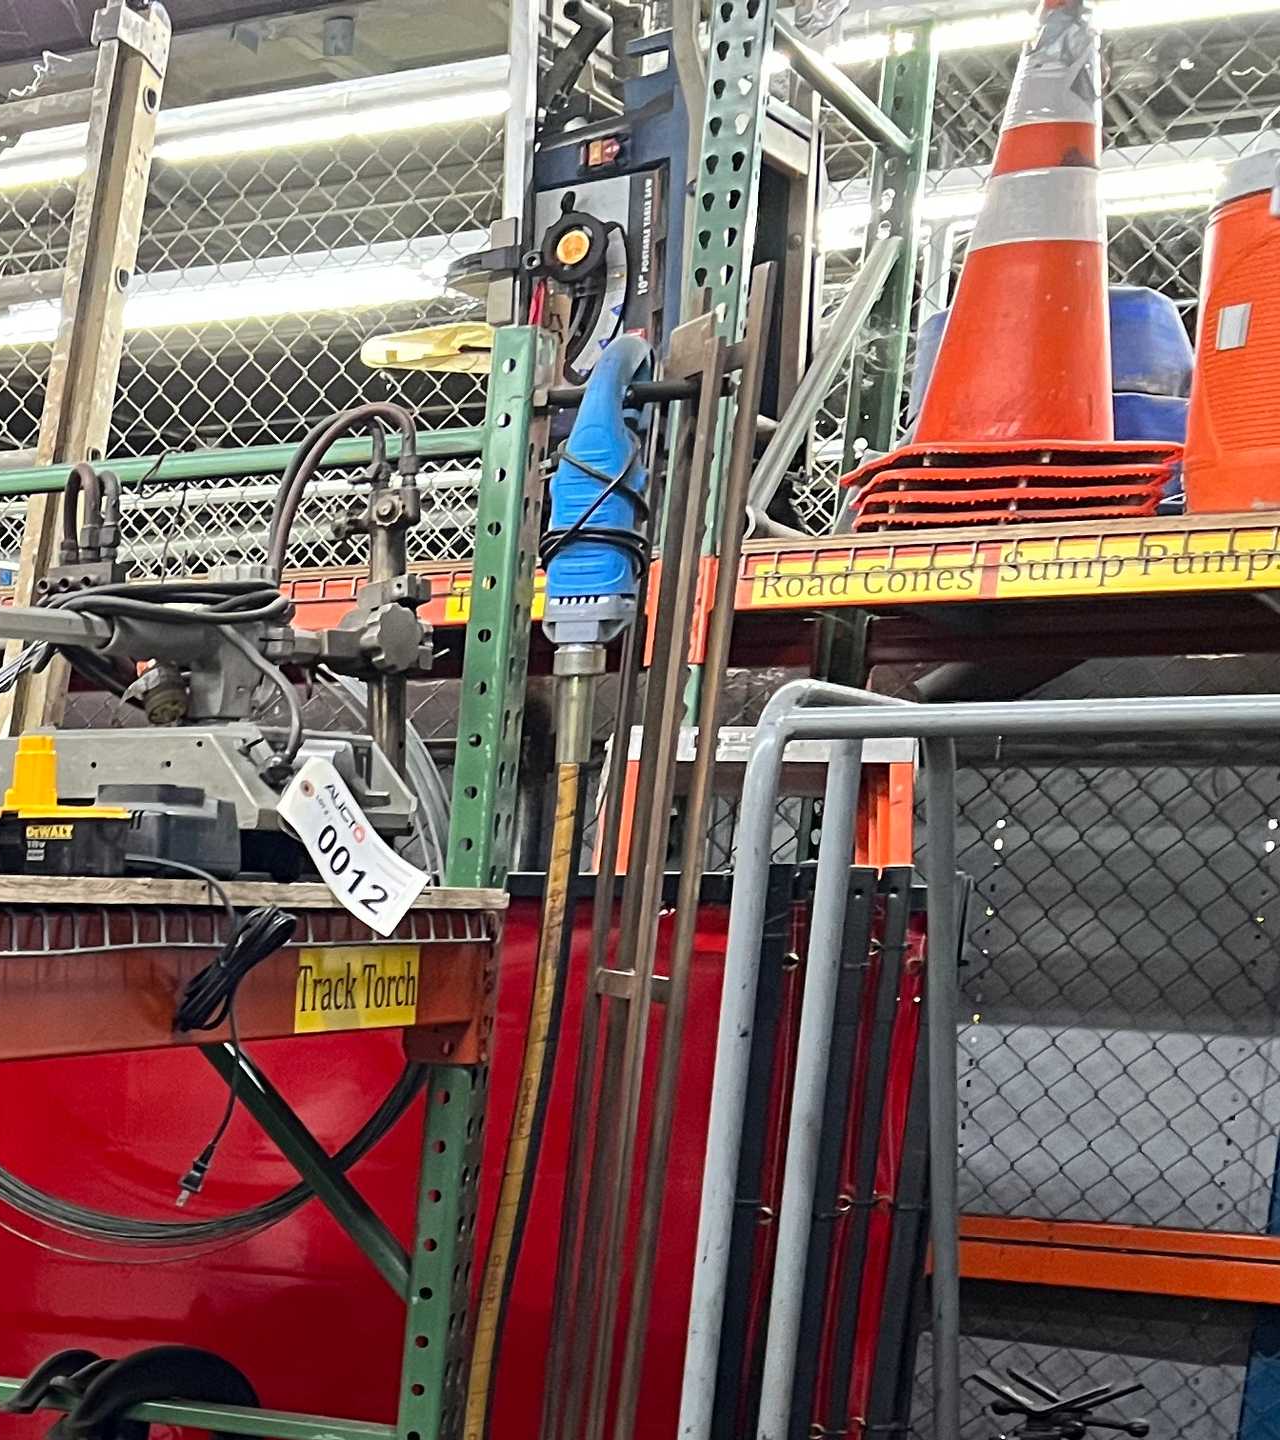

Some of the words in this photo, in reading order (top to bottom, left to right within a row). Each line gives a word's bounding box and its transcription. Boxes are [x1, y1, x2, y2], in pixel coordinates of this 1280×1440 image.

[760, 565, 849, 599] Road
[863, 565, 976, 594] Cones
[1000, 549, 1124, 588] Sump
[1142, 543, 1280, 582] Pump
[317, 824, 389, 916] 0012
[298, 964, 357, 1013] Track
[362, 959, 417, 1010] Torch
